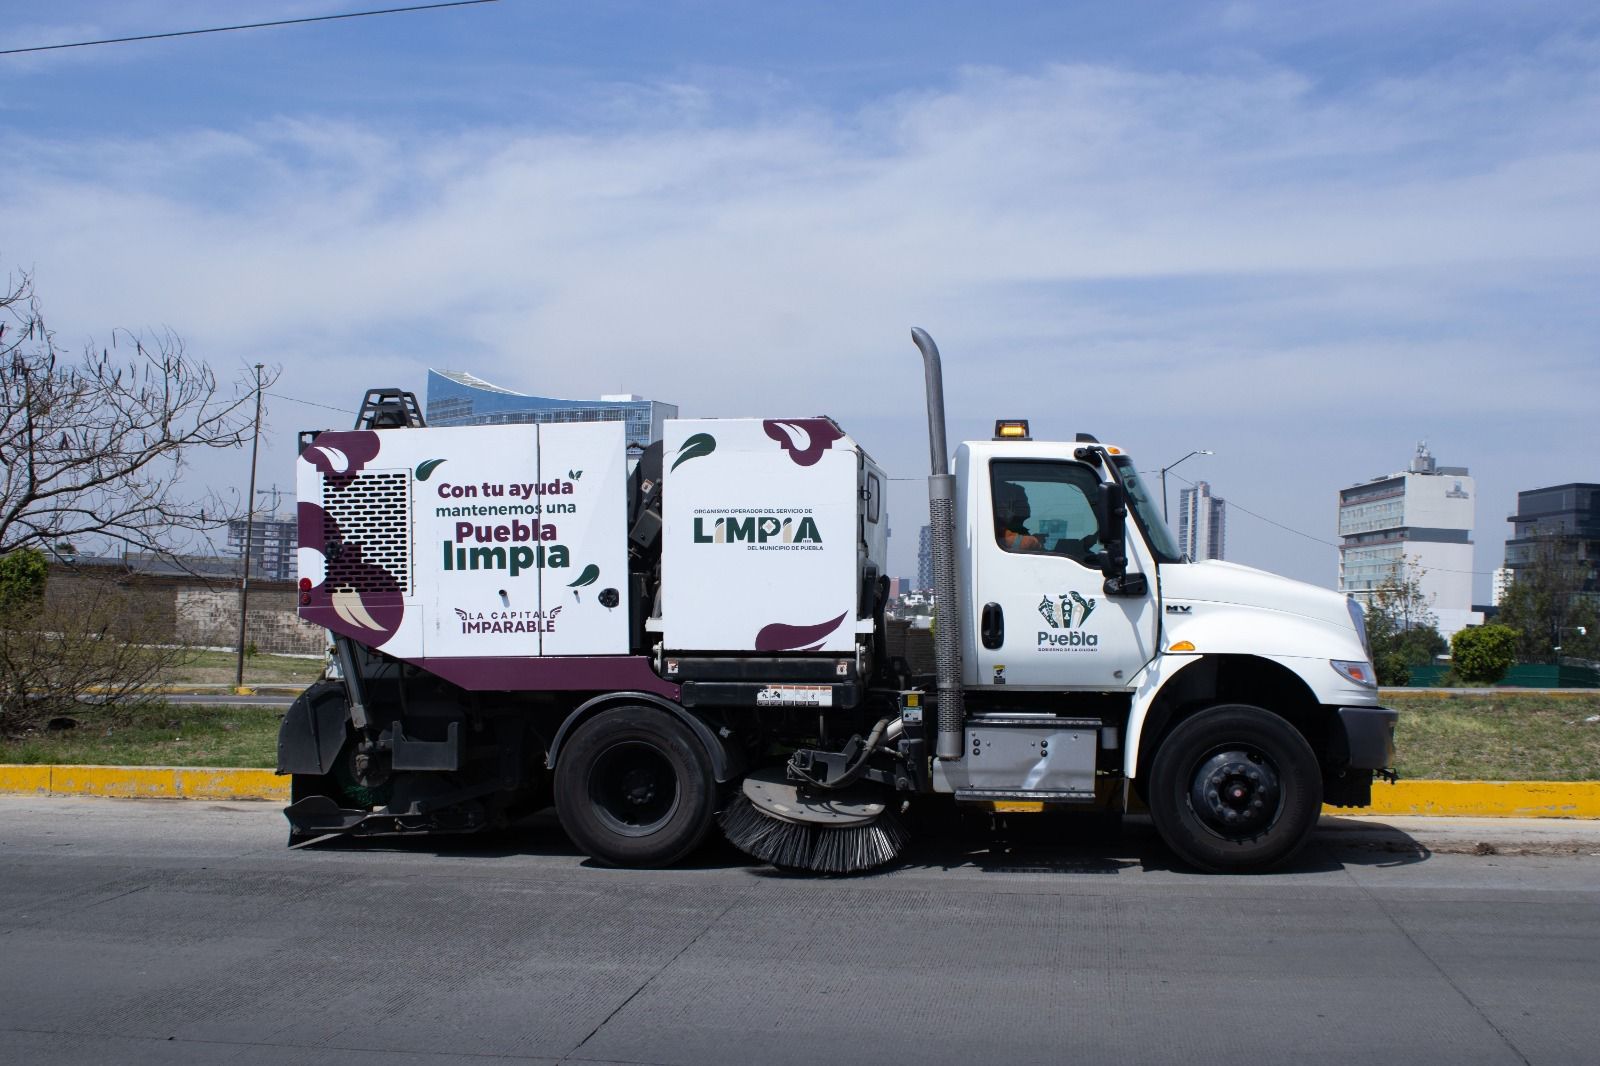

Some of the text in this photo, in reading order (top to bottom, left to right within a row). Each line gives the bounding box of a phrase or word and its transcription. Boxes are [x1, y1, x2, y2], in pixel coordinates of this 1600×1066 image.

[438, 478, 574, 500] Con tu ayuda
[436, 503, 577, 517] mantenemos una
[455, 518, 557, 543] Puebla
[443, 540, 570, 577] limpia
[469, 610, 547, 620] LA CAPITAL
[462, 620, 556, 634] IMPARABLE
[1037, 631, 1098, 646] Puebla
